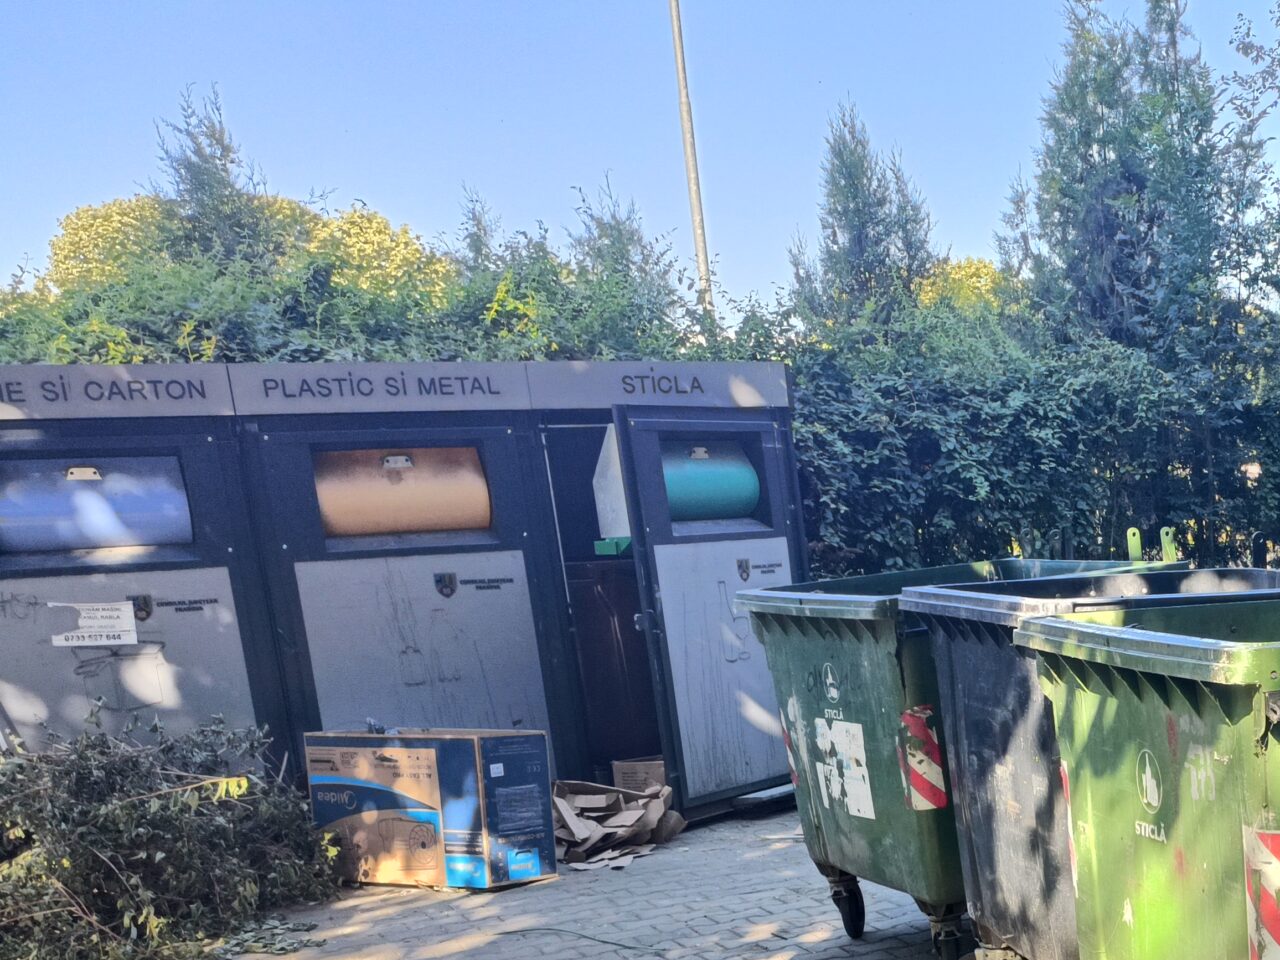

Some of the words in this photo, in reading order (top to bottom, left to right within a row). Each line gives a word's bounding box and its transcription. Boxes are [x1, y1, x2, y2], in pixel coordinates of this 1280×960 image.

[84, 379, 207, 401] CARTON
[417, 376, 501, 396] METAL
[317, 790, 358, 810] Midea
